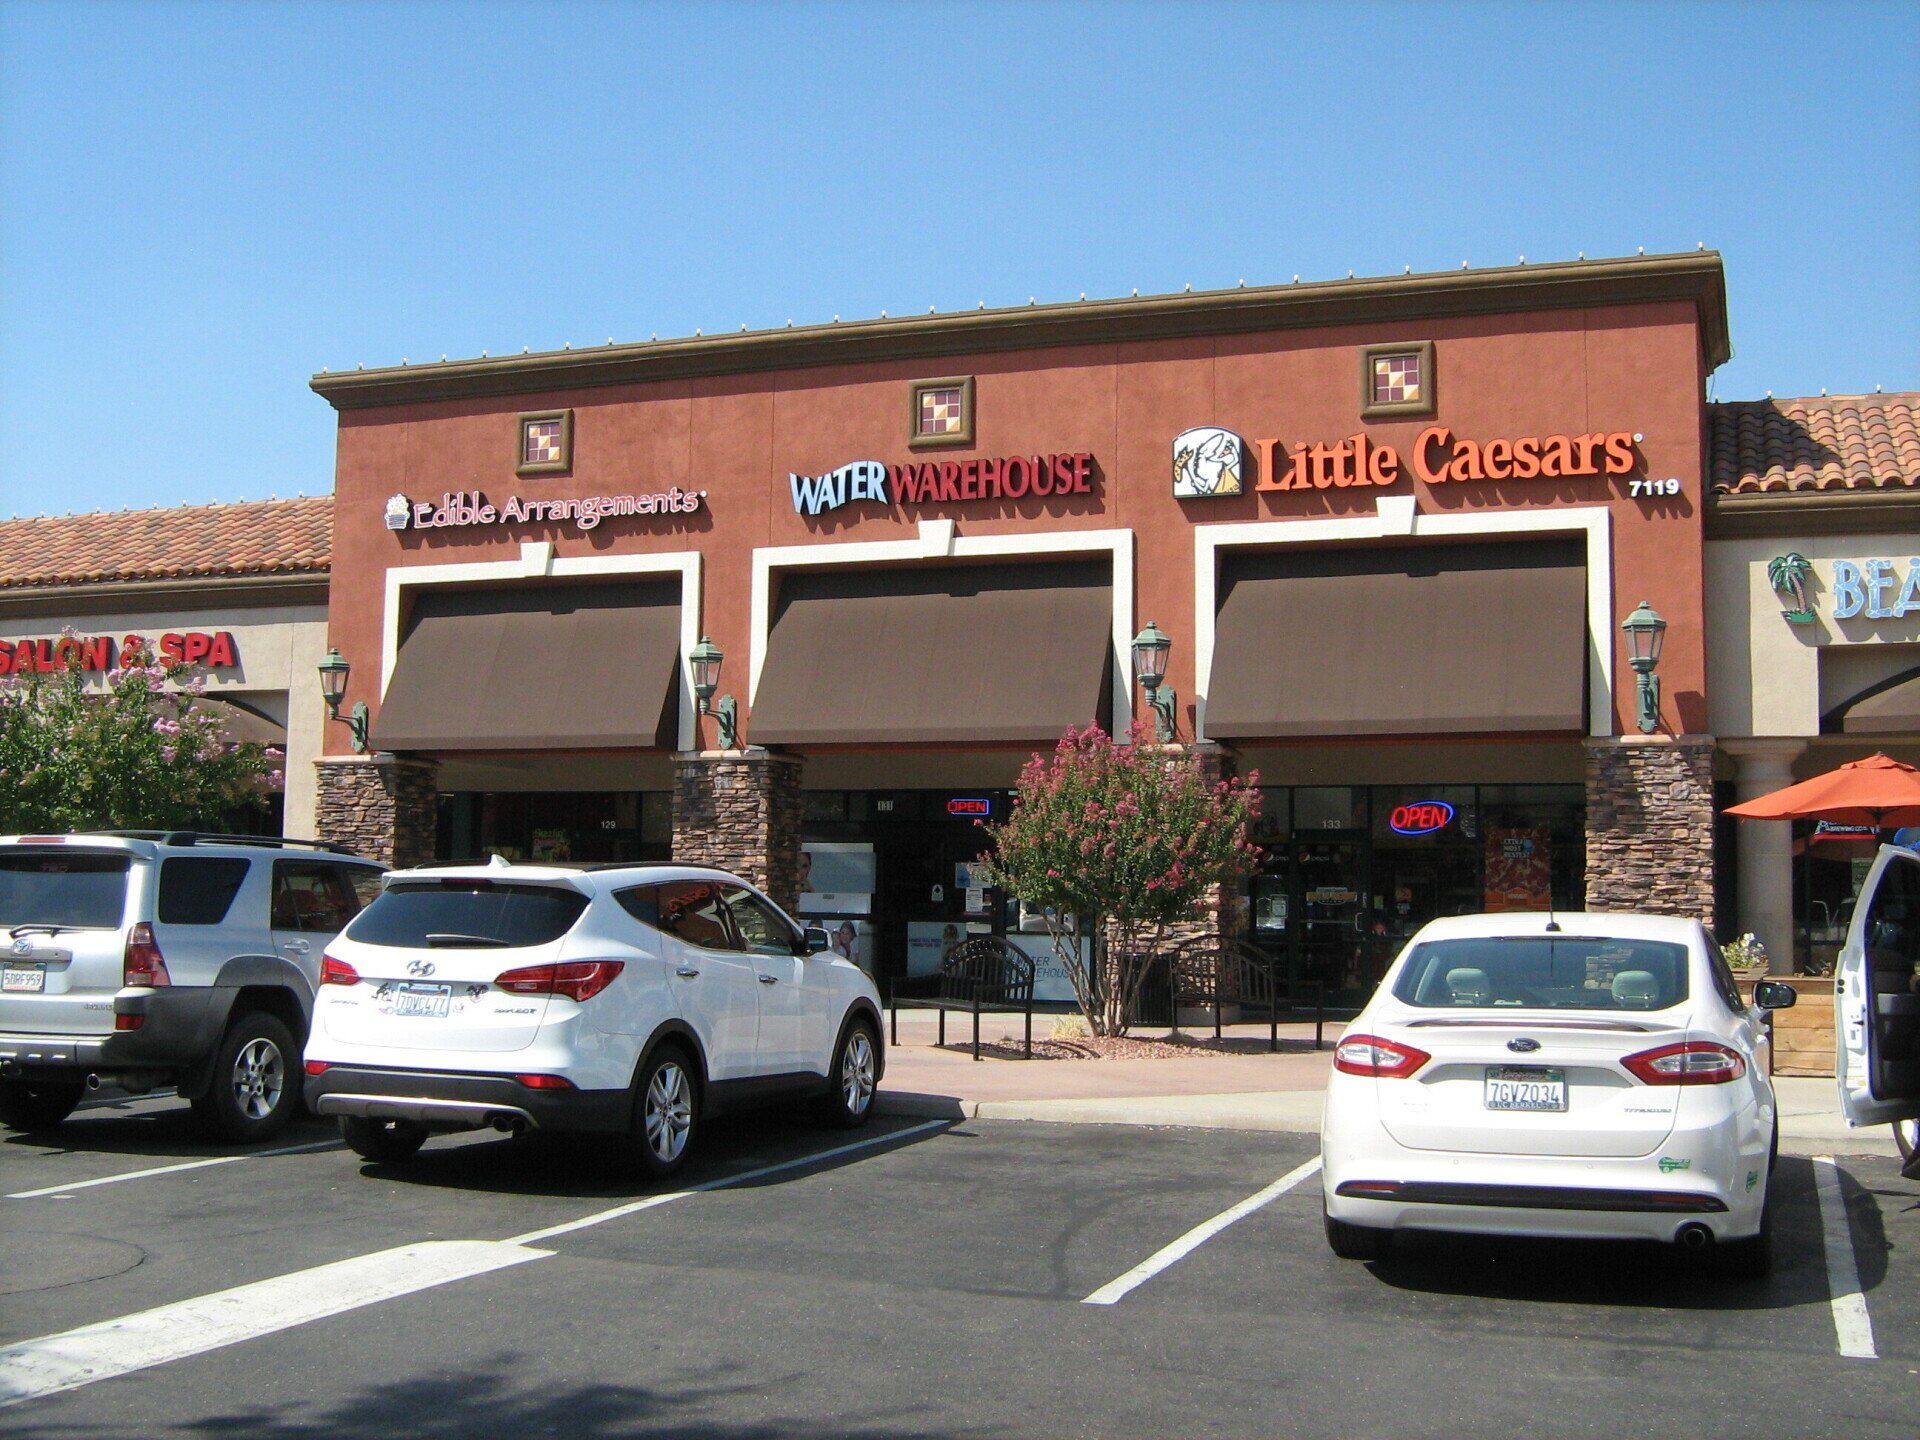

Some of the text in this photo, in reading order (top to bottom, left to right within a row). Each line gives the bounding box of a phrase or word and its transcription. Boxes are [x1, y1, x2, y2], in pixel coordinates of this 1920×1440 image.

[1255, 426, 1634, 491] Little Caesars
[789, 452, 1092, 515] WATER WAREHOUSE
[1628, 479, 1679, 497] 7119
[413, 487, 699, 530] Edible Arrangements
[159, 631, 234, 669] SPA
[947, 801, 986, 812] OPEN
[1392, 805, 1447, 828] OPEN
[601, 821, 616, 829] 129
[1322, 819, 1341, 829] 133
[1490, 1082, 1560, 1102] 7GVZ034
